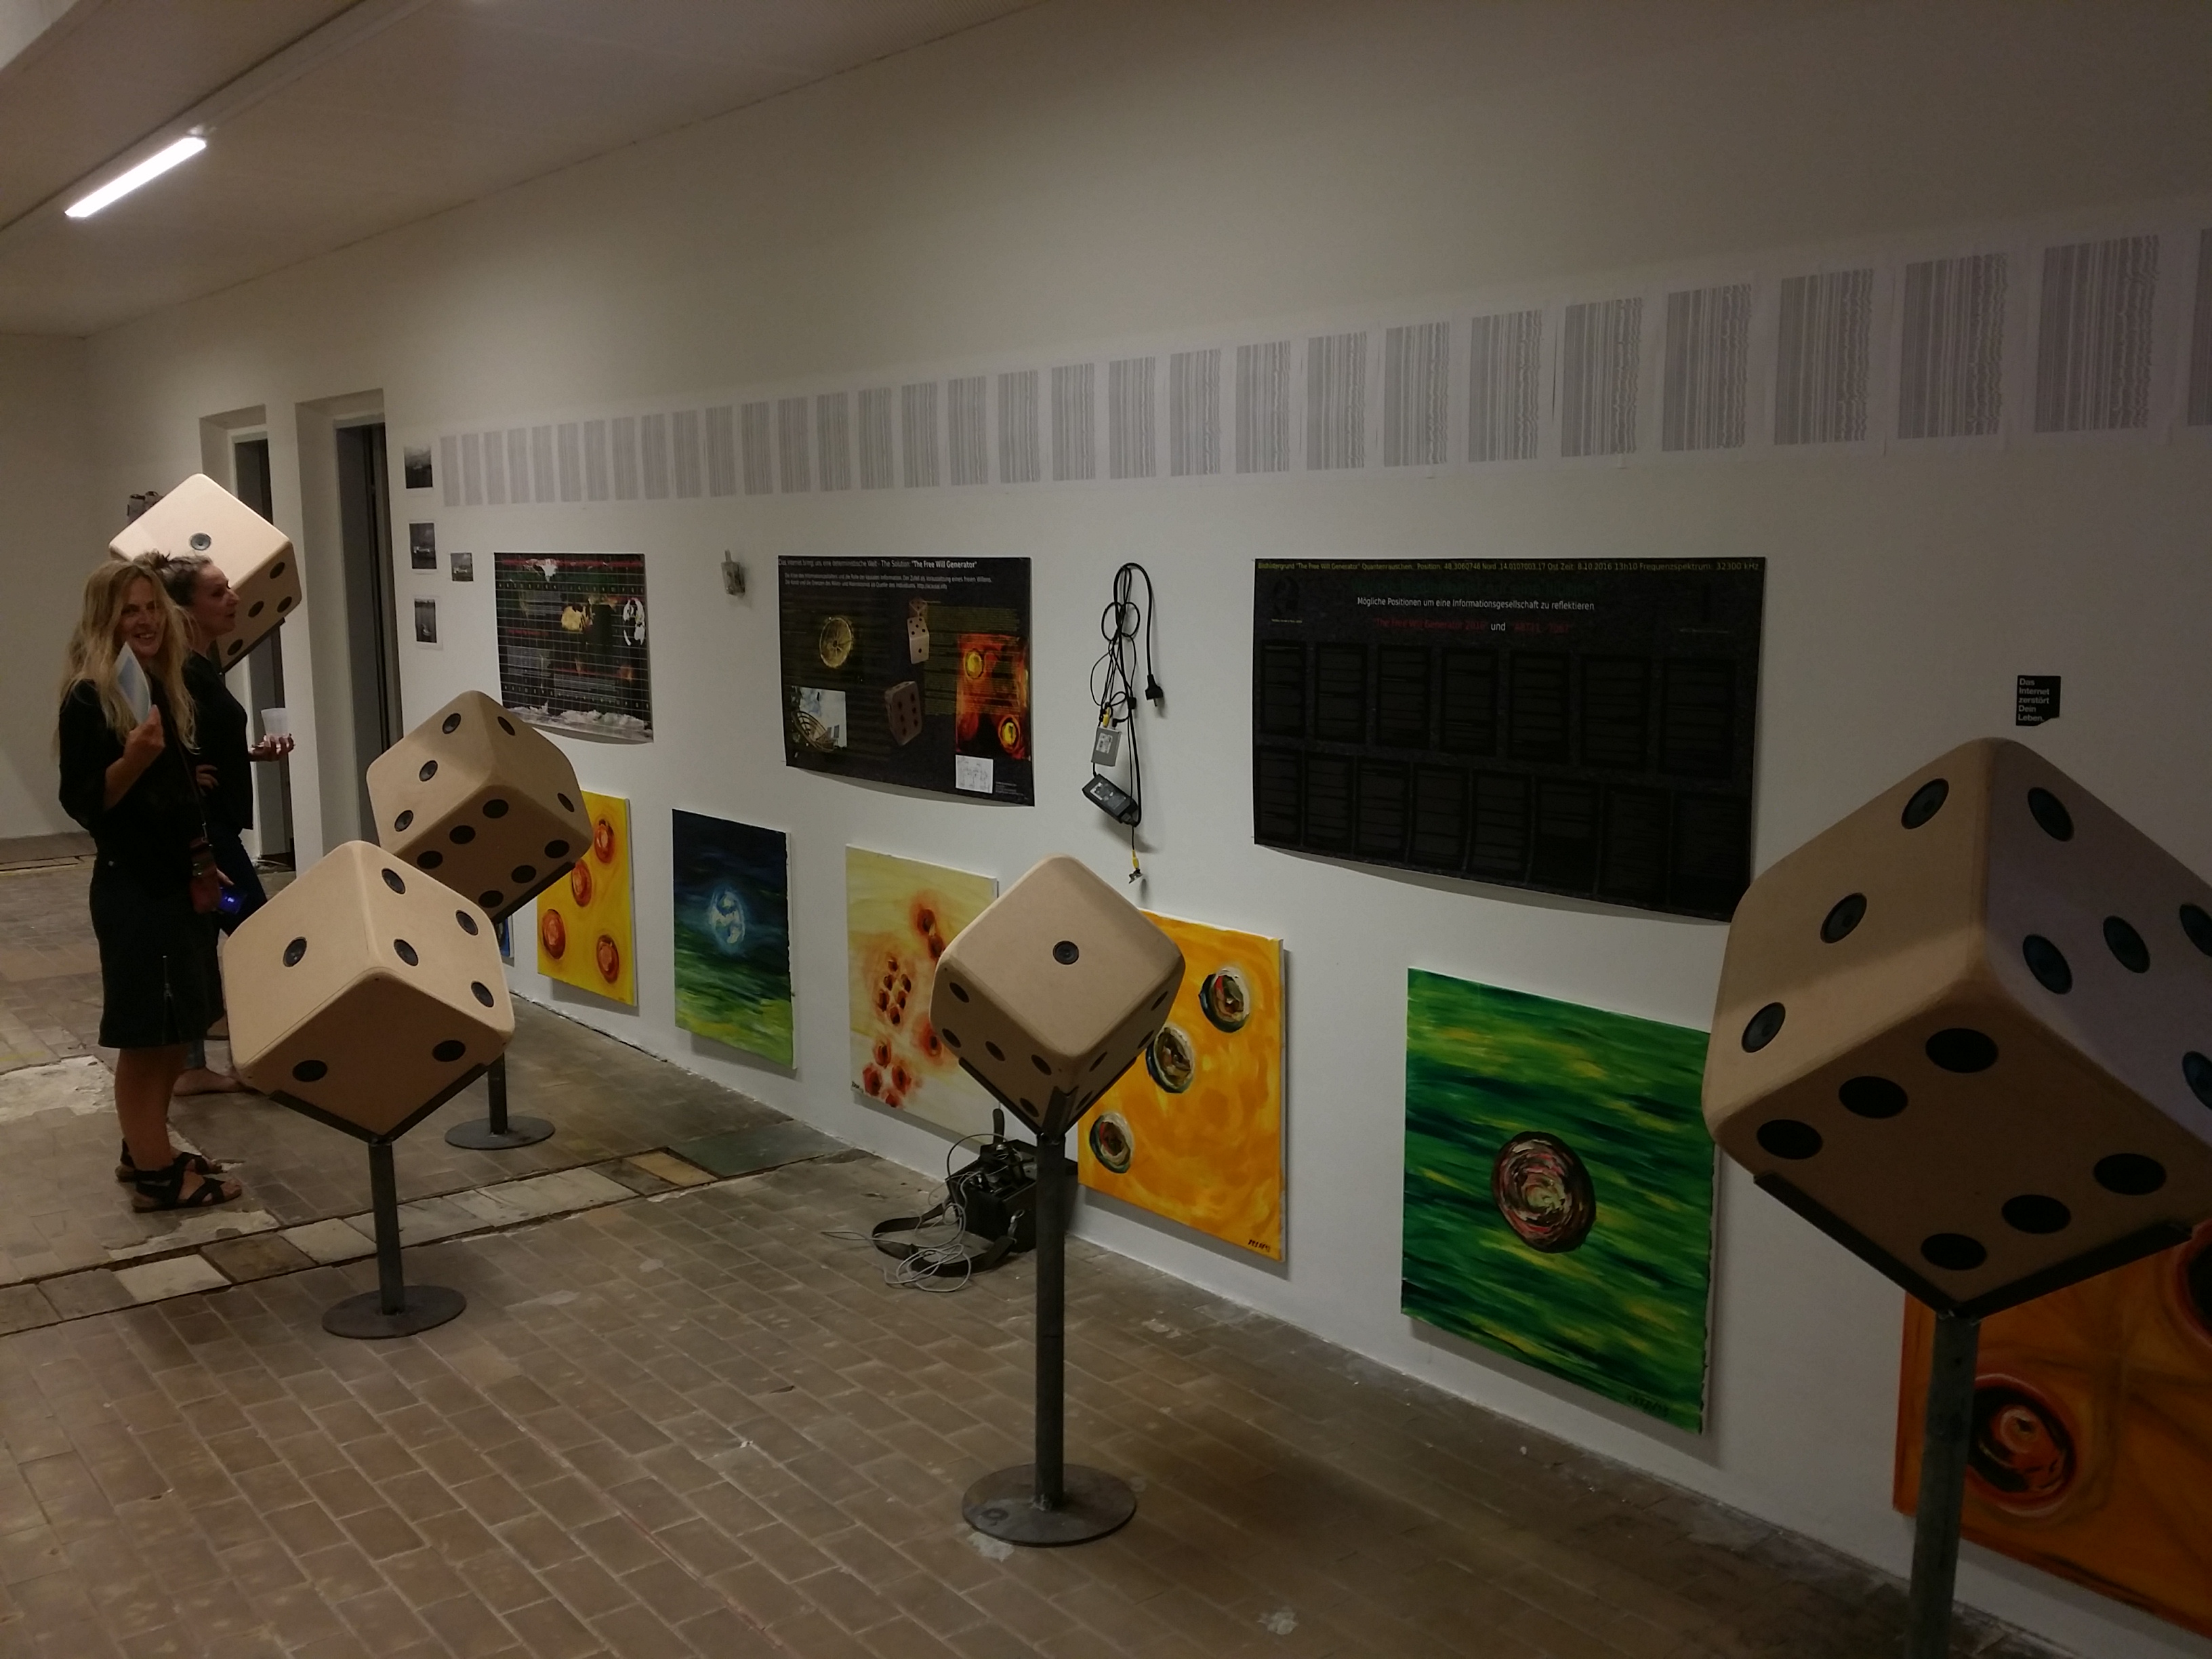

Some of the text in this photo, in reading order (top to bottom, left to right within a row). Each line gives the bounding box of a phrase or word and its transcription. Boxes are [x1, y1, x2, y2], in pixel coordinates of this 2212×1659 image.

[1615, 562, 1638, 571] 13h10
[1357, 596, 1386, 607] Mögliche
[1387, 597, 1422, 607] Positionen
[1435, 598, 1451, 607] eine
[1452, 598, 1539, 610] Informationsgesellschaft
[1551, 600, 1595, 611] reflektieren
[1490, 622, 1507, 632] und
